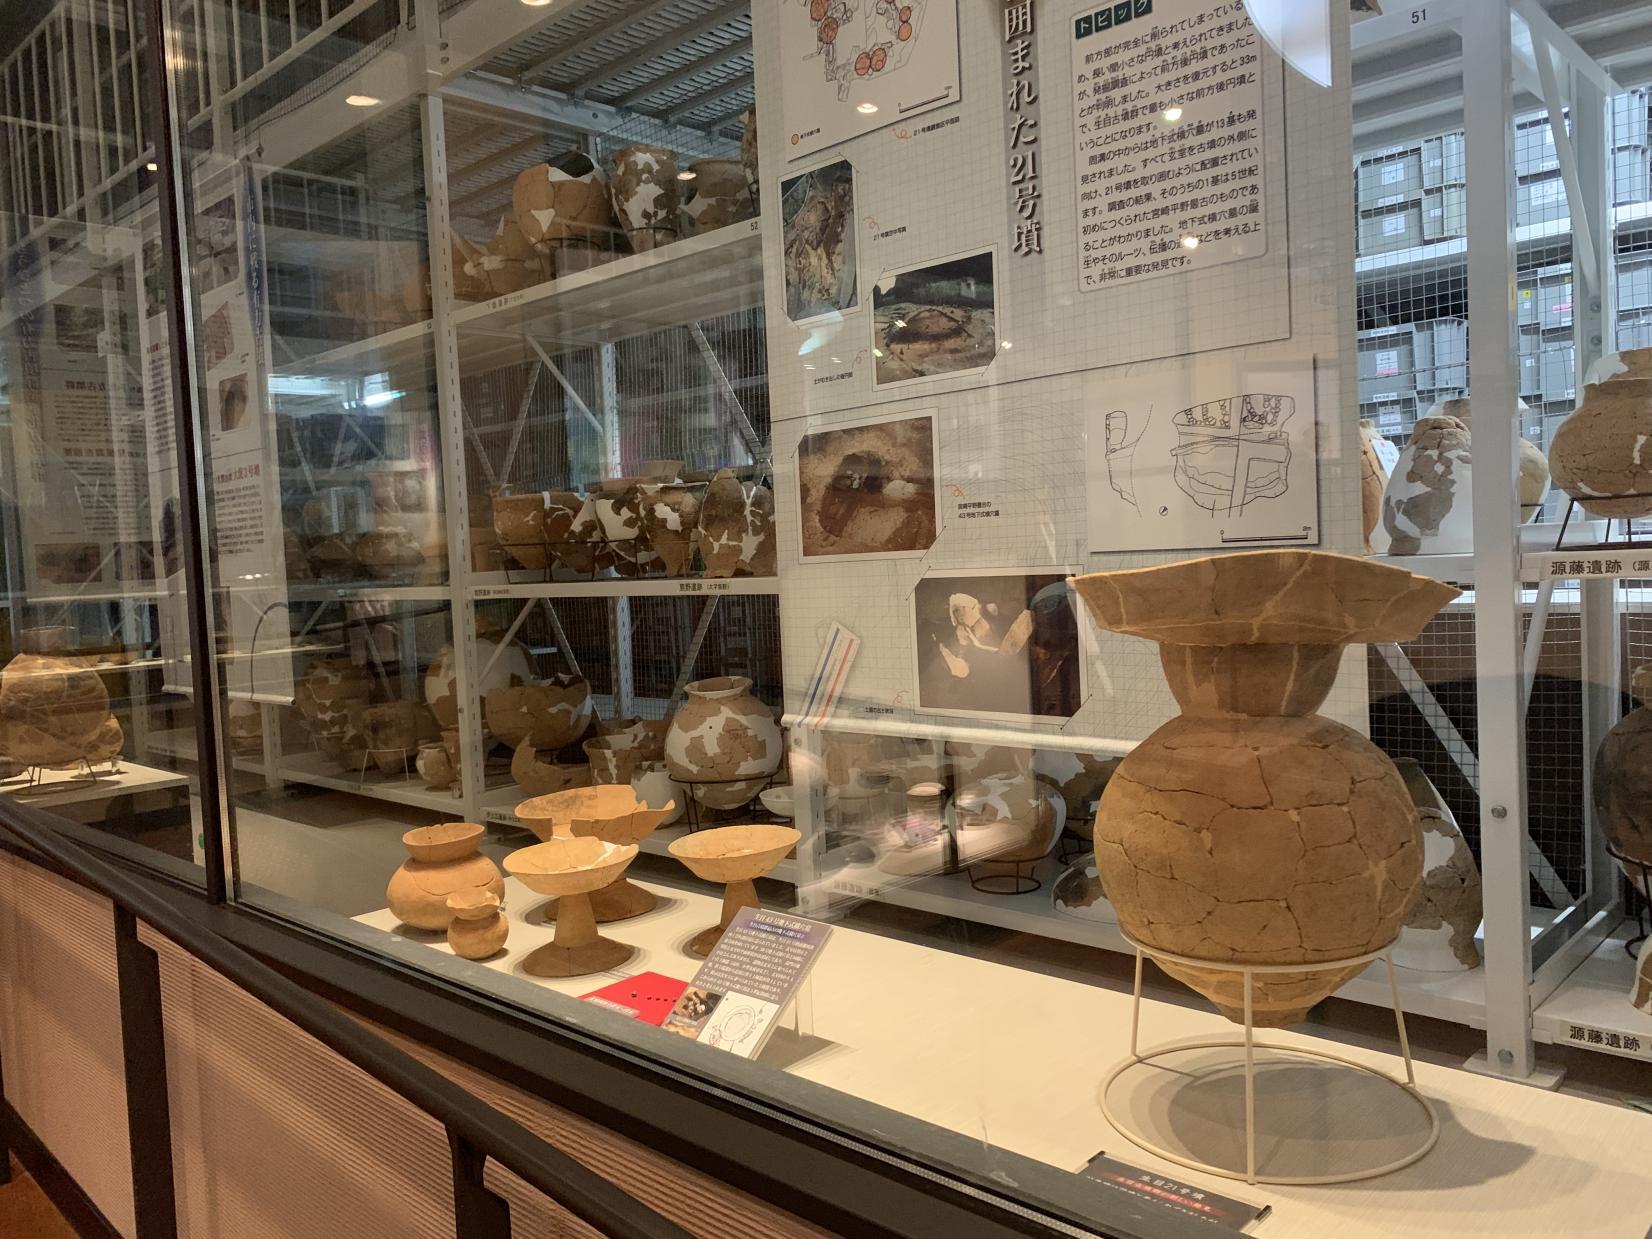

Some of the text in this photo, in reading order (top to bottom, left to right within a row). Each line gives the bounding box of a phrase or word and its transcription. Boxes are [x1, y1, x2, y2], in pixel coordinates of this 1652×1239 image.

[1411, 8, 1426, 24] 51
[1004, 0, 1041, 256] 囲まれた21号墳
[1080, 121, 1158, 151] いうことになります。
[750, 221, 759, 231] 52
[1084, 255, 1192, 285] で、非常に重要な発見です。
[1550, 559, 1622, 575] 源藤遺跡
[1569, 1025, 1641, 1052] 源藤遺跡
